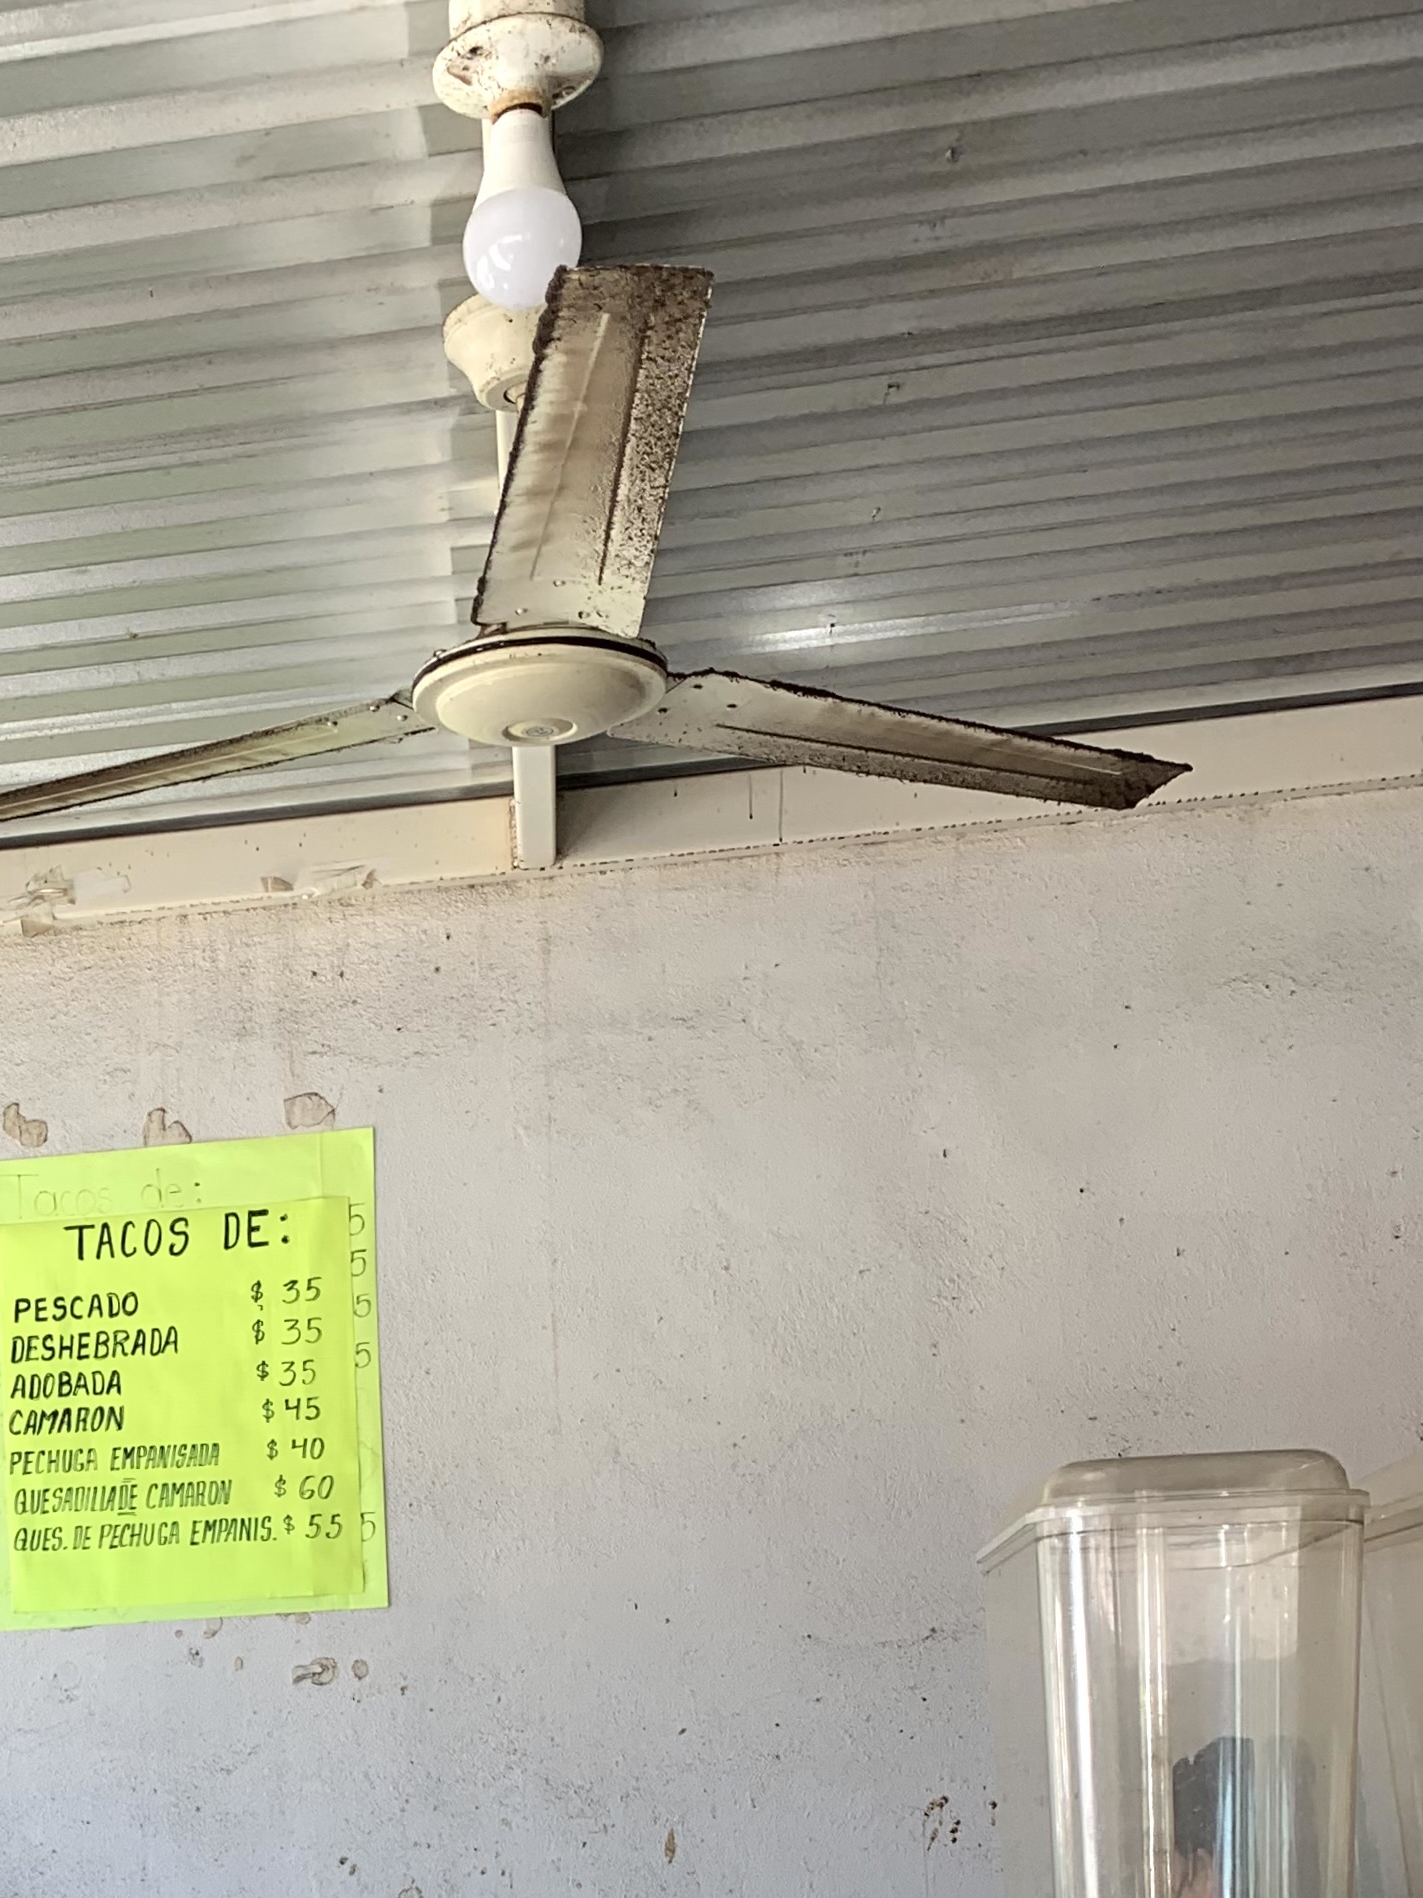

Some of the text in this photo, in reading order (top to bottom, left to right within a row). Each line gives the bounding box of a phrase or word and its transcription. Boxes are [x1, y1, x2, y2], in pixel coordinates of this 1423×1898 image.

[140, 1168, 202, 1209] de:
[63, 1208, 290, 1261] TACOS DE:
[13, 1291, 139, 1324] PESCADO
[281, 1276, 323, 1305] 35
[10, 1325, 179, 1364] DESHEBRADA
[281, 1317, 323, 1345] 35
[10, 1369, 122, 1400] ADOBADA
[279, 1358, 317, 1387] 35
[8, 1405, 125, 1436] CAMARON
[284, 1396, 322, 1421] 45
[9, 1447, 98, 1475] PECHUGA
[109, 1442, 220, 1471] EMPANISADA
[291, 1437, 326, 1460] 40
[145, 1479, 233, 1509] CAMARON
[298, 1475, 335, 1500] 60
[13, 1526, 68, 1552] QUES.
[72, 1525, 92, 1550] DE
[97, 1521, 180, 1549] PECHUGA
[189, 1515, 278, 1546] EMPANIS.
[304, 1513, 343, 1540] 55
